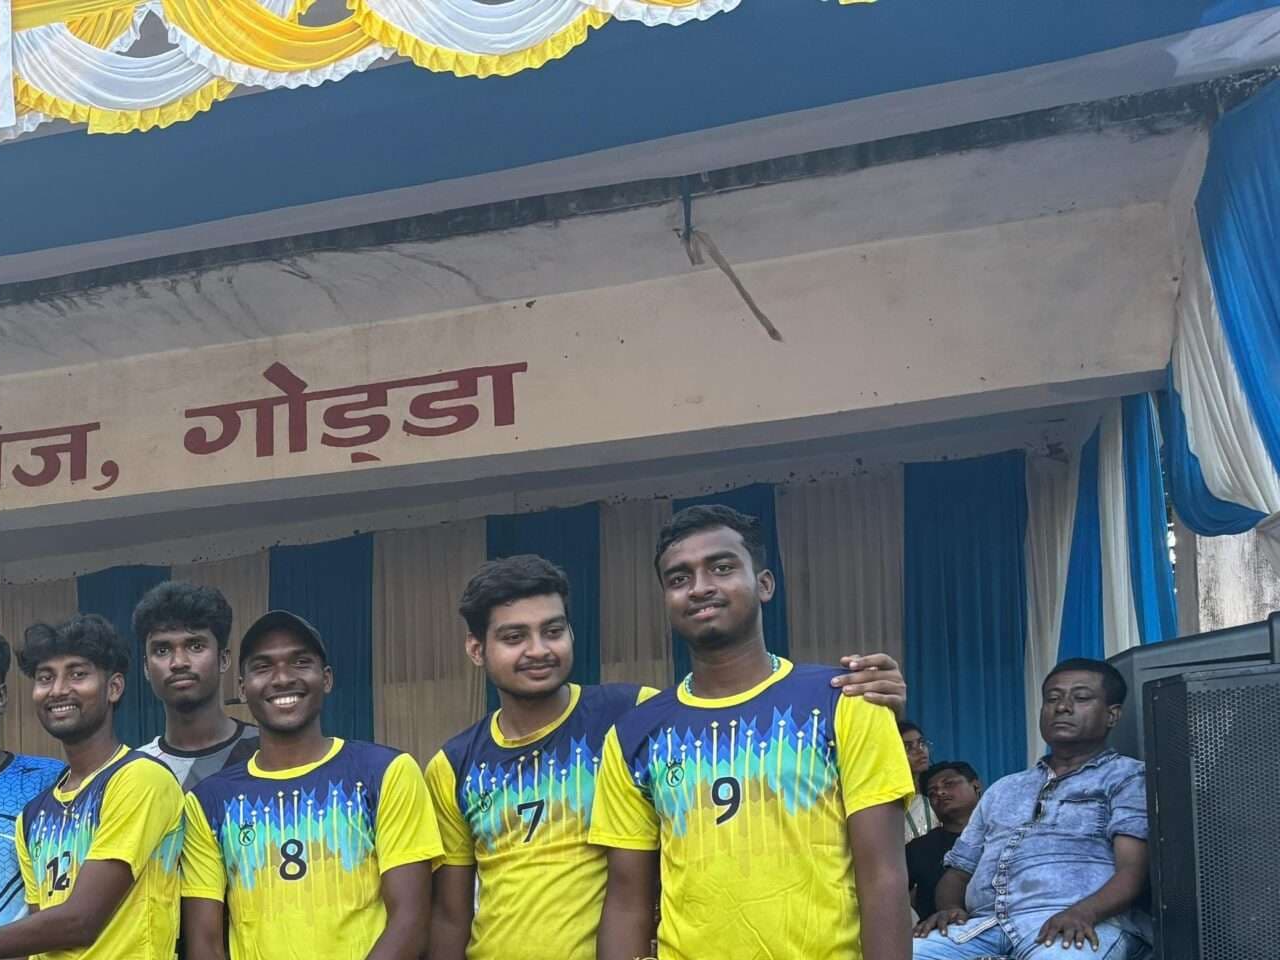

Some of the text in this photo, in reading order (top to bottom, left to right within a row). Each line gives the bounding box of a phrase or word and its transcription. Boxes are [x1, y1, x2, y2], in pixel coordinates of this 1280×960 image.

[183, 361, 528, 463] गोड्डा
[517, 799, 545, 844] 7
[711, 776, 742, 826] 9
[279, 838, 308, 881] 8
